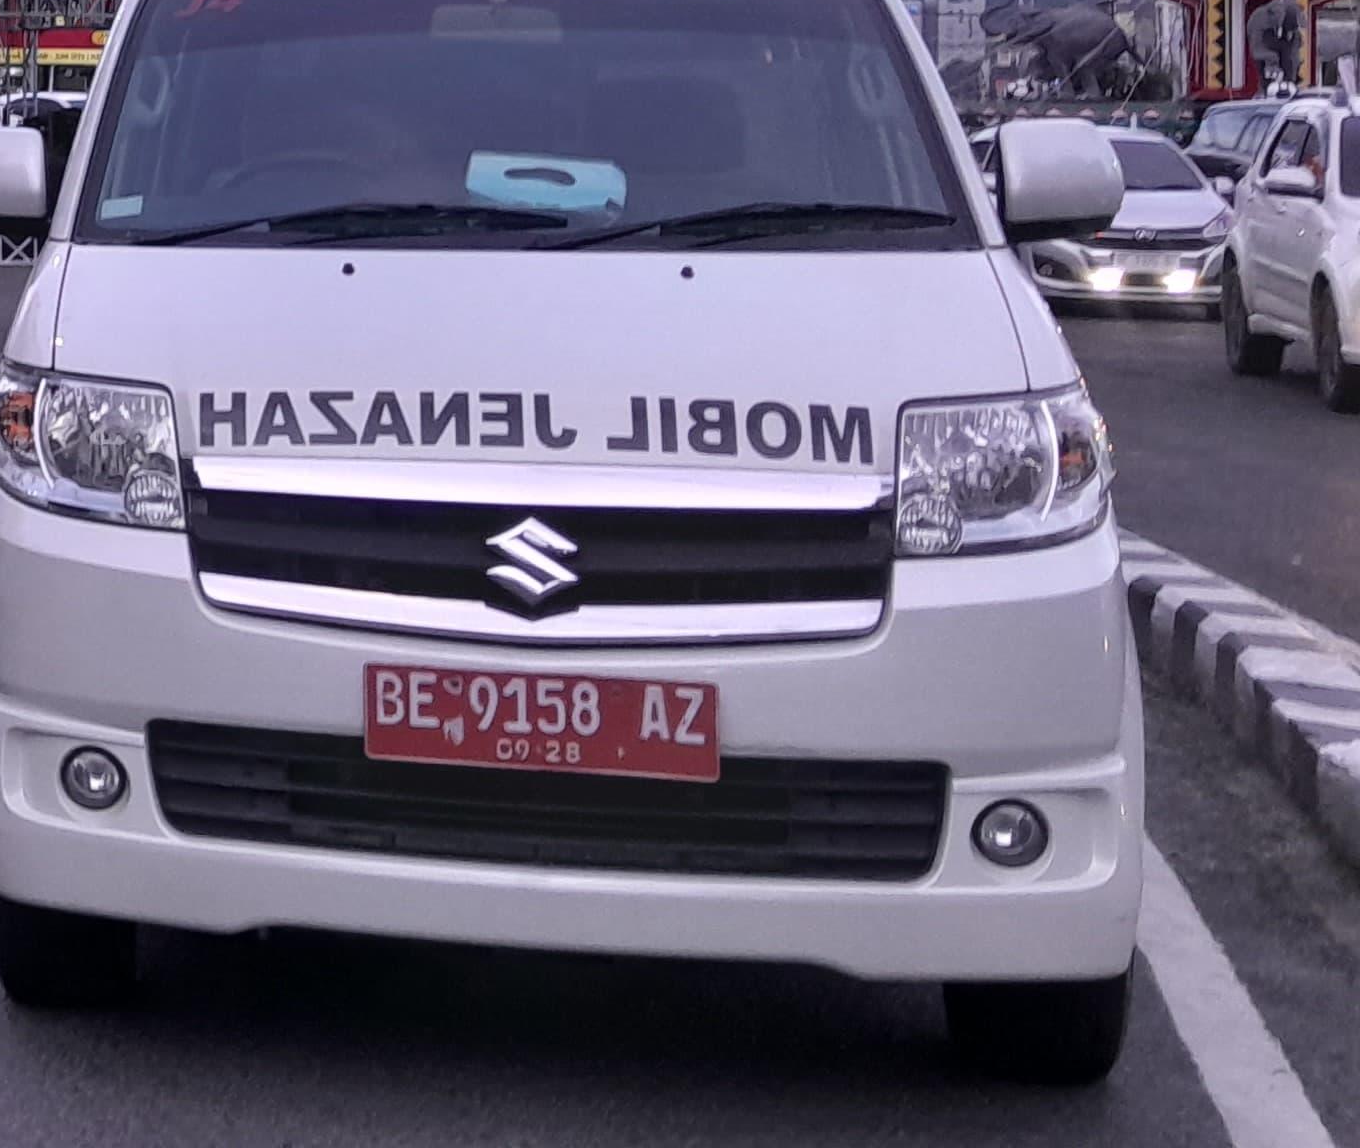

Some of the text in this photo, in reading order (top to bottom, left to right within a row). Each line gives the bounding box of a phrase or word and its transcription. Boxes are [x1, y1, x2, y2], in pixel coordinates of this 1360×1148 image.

[375, 670, 706, 745] BE 9158 AZ
